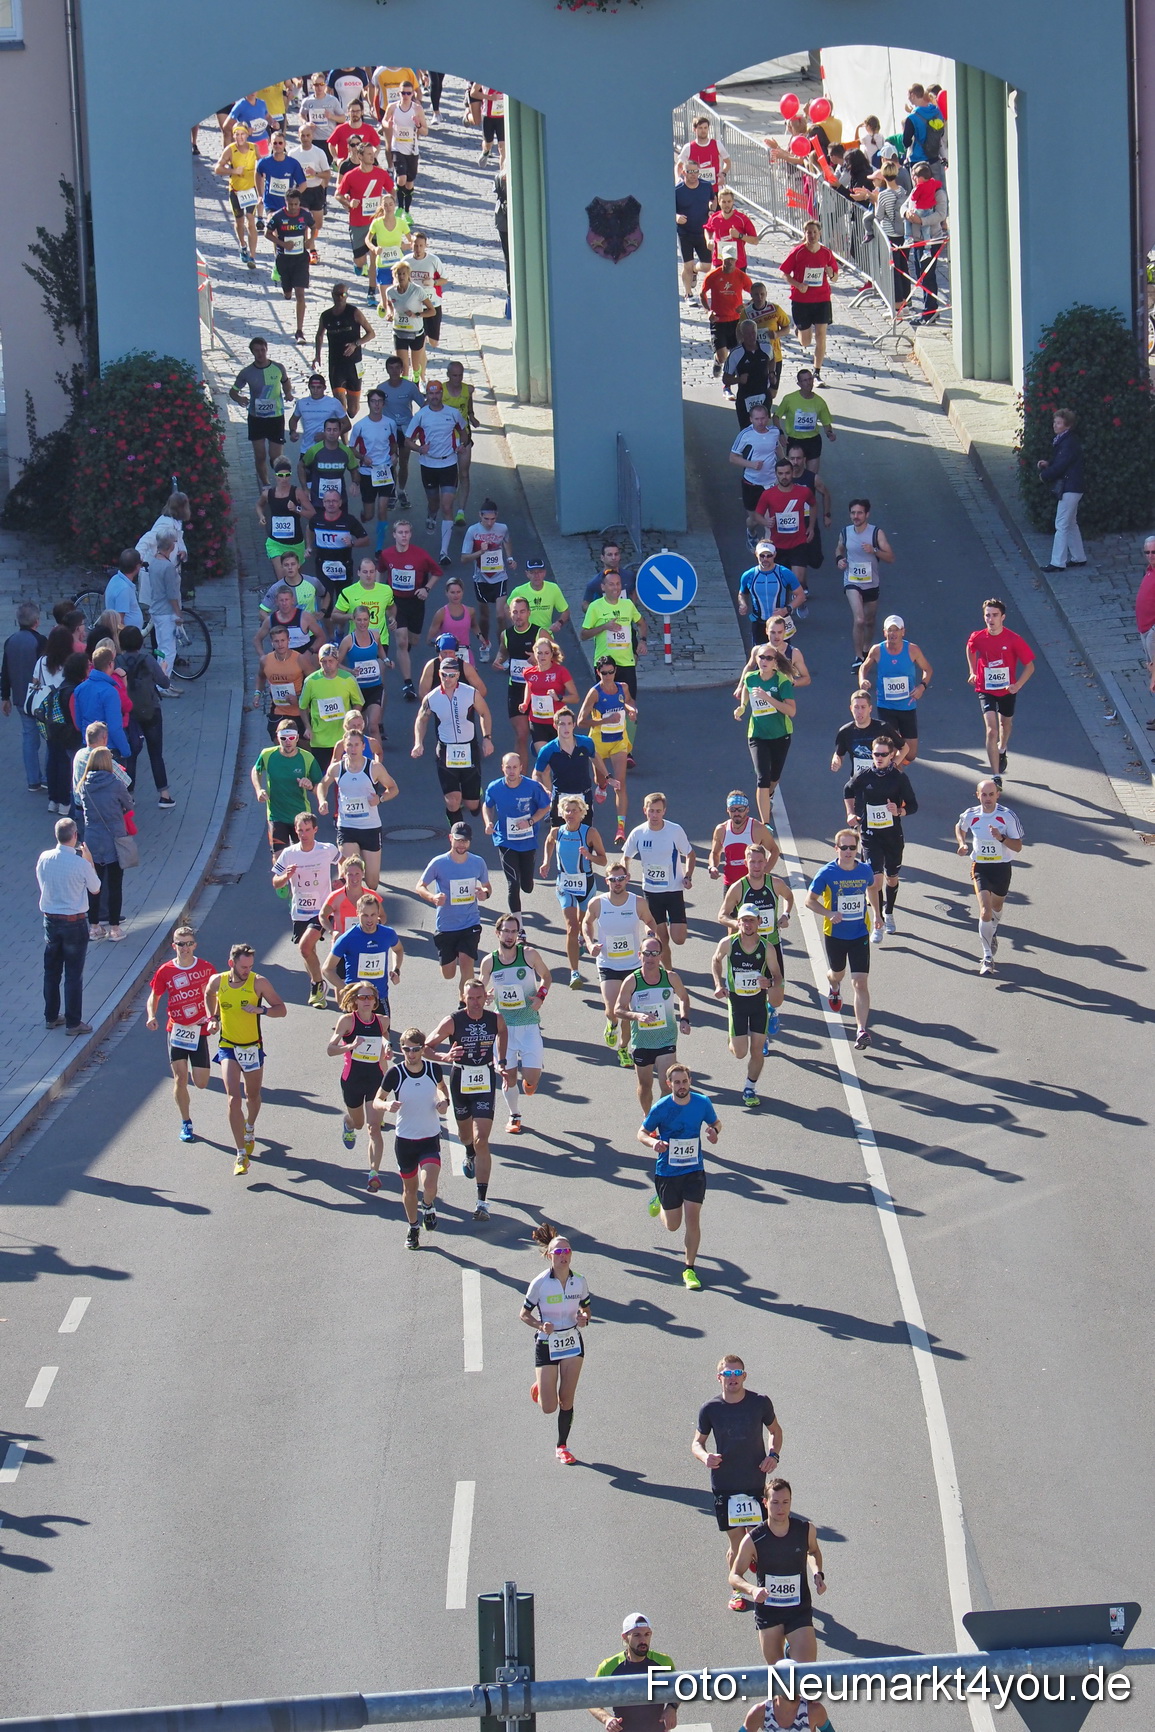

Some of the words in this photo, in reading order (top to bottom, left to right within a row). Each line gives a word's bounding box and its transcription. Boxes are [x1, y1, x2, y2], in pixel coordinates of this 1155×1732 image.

[383, 250, 398, 258] 2616
[486, 556, 499, 564] 299
[326, 566, 343, 574] 2318
[853, 567, 867, 575] 216
[394, 575, 411, 583] 2487
[612, 632, 626, 640] 198
[359, 666, 377, 675] 2372
[988, 673, 1006, 681] 2462
[887, 682, 906, 691] 3008
[324, 703, 338, 712] 280
[538, 701, 544, 710] 3
[452, 696, 462, 734] DYNAMICS
[452, 750, 466, 759] 176
[345, 803, 365, 812] 2371
[872, 812, 886, 820] 183
[981, 845, 996, 854] 213
[647, 869, 666, 879] 2278
[563, 880, 583, 889] 2019
[459, 886, 470, 895] 84
[298, 898, 317, 907] 2267
[841, 901, 861, 910] 3034
[612, 940, 629, 950] 328
[365, 960, 380, 969] 217
[742, 979, 757, 987] 178
[503, 991, 518, 1000] 244
[175, 1028, 196, 1040] 2226
[366, 1043, 372, 1052] 7
[468, 1074, 484, 1083] 148
[673, 1145, 695, 1155] 2145
[553, 1336, 576, 1349] 3128
[736, 1502, 753, 1513] 311
[770, 1583, 796, 1594] 2486
